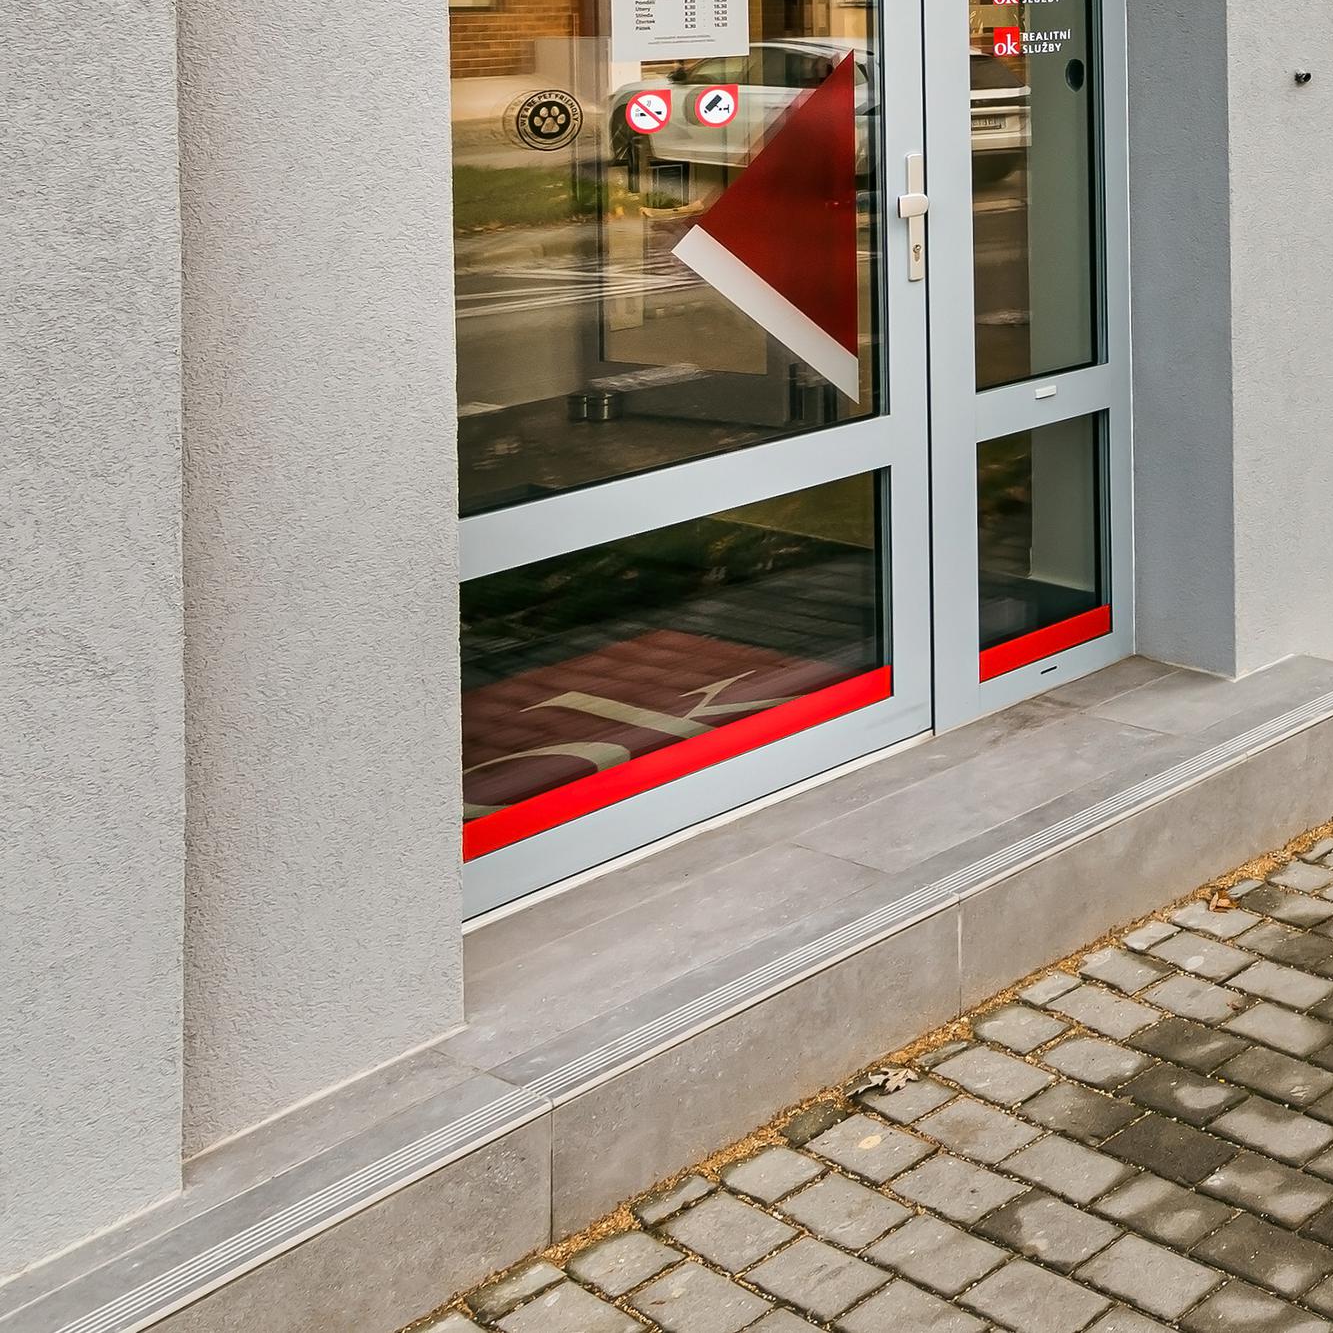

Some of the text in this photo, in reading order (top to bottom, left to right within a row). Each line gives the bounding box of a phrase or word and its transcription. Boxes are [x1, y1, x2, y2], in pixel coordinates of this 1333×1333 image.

[1022, 28, 1071, 41] REALITNÍ
[994, 33, 1019, 55] ok
[1022, 42, 1062, 54] SLUŽBY
[519, 93, 579, 127] WE ARE PET FRIENDLY
